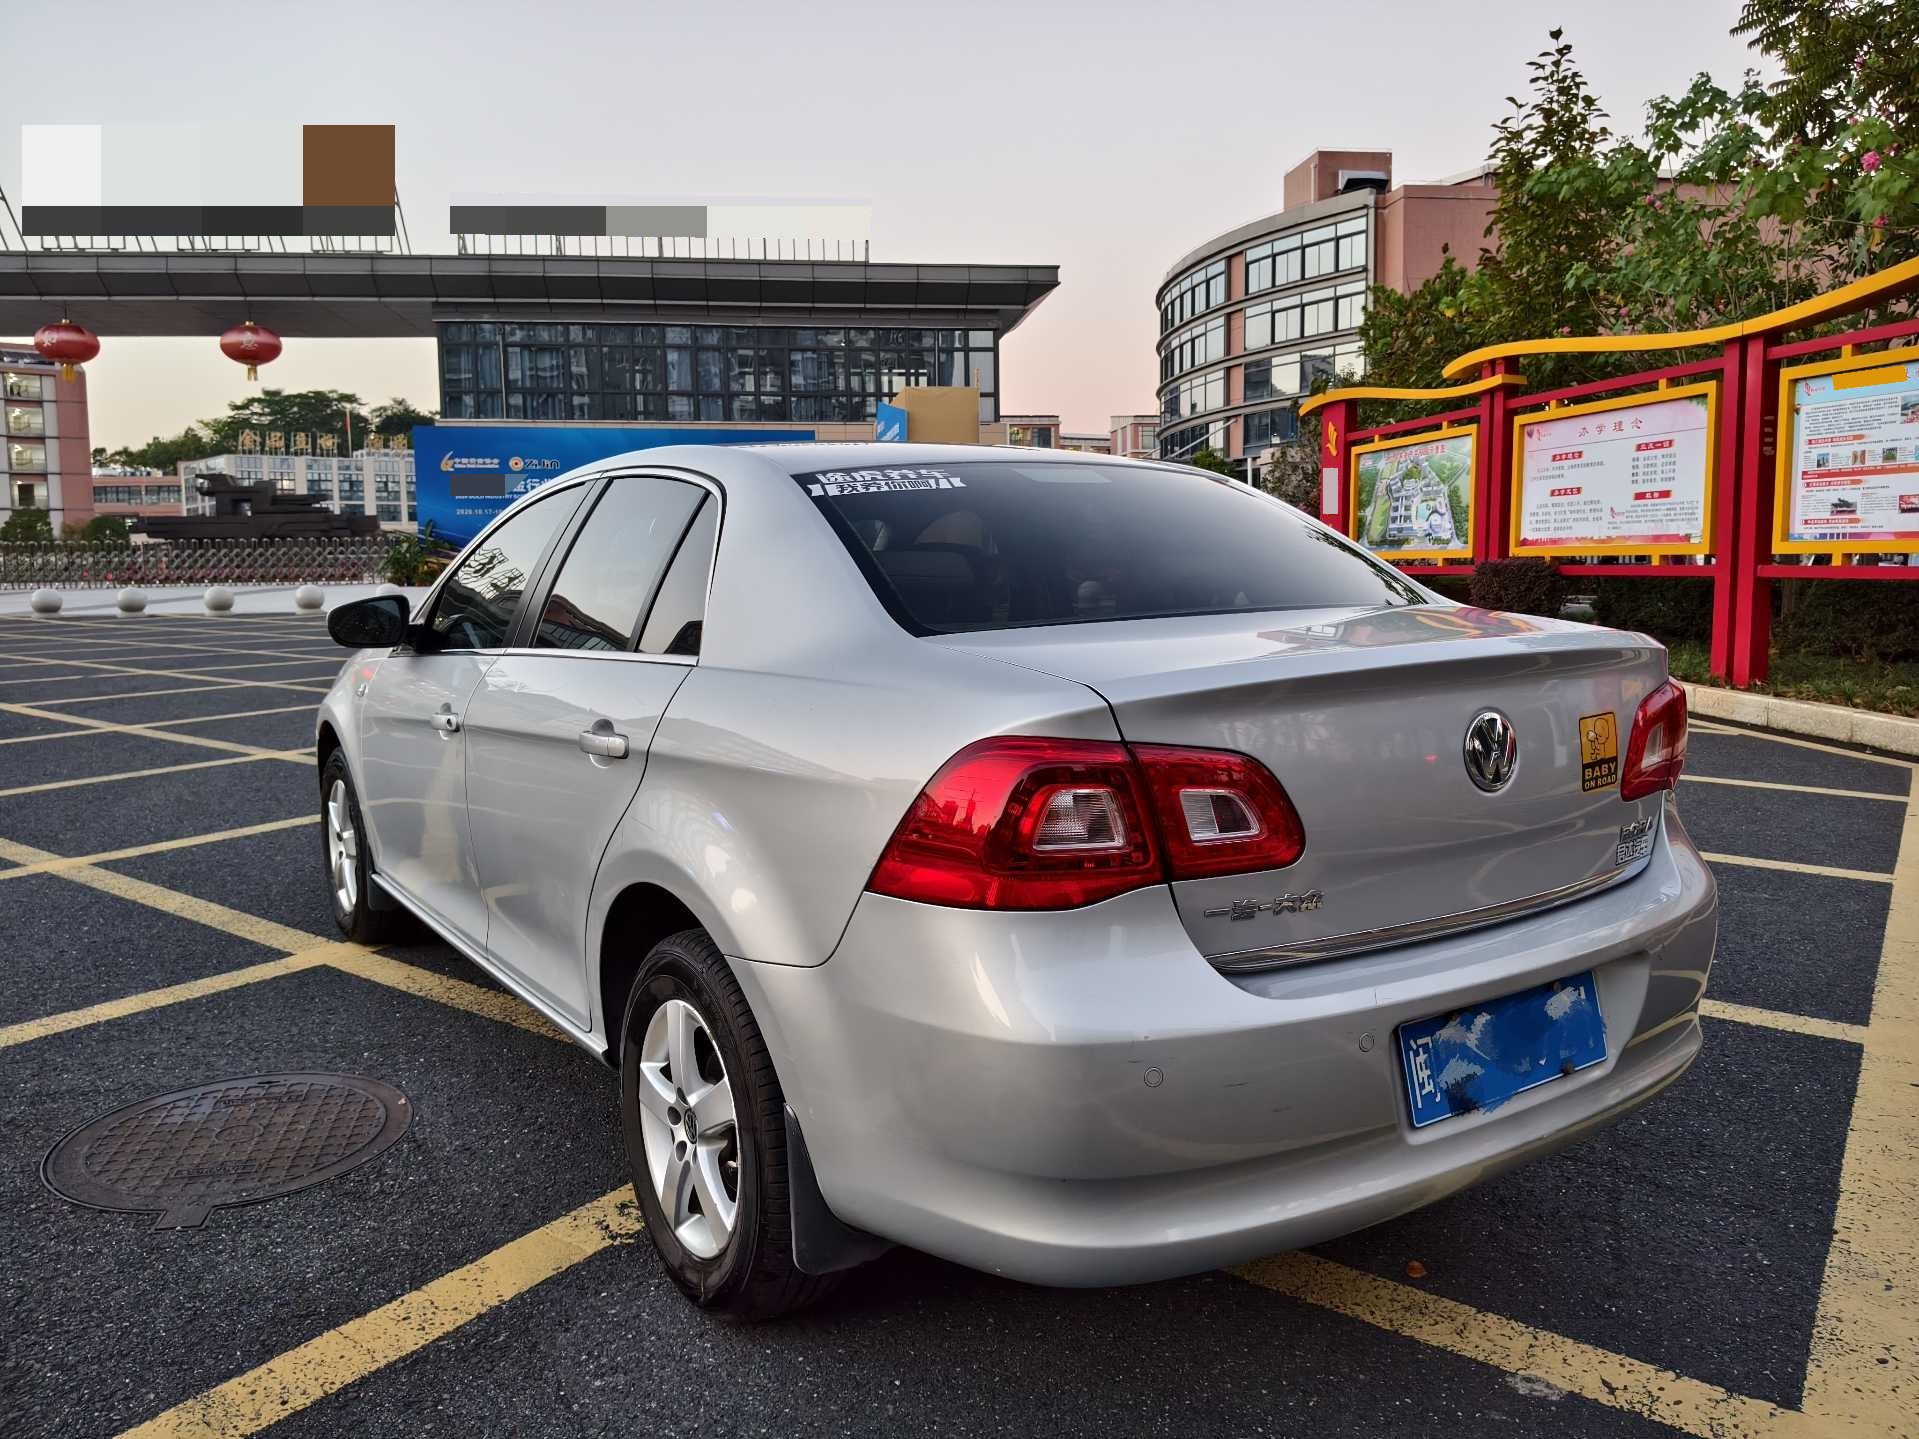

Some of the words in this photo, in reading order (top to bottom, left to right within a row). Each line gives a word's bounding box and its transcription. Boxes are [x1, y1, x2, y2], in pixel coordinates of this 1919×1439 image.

[816, 469, 951, 484] 途虎养车
[1584, 761, 1617, 780] BABY
[1584, 781, 1596, 790] ON
[1597, 773, 1616, 786] ROAD
